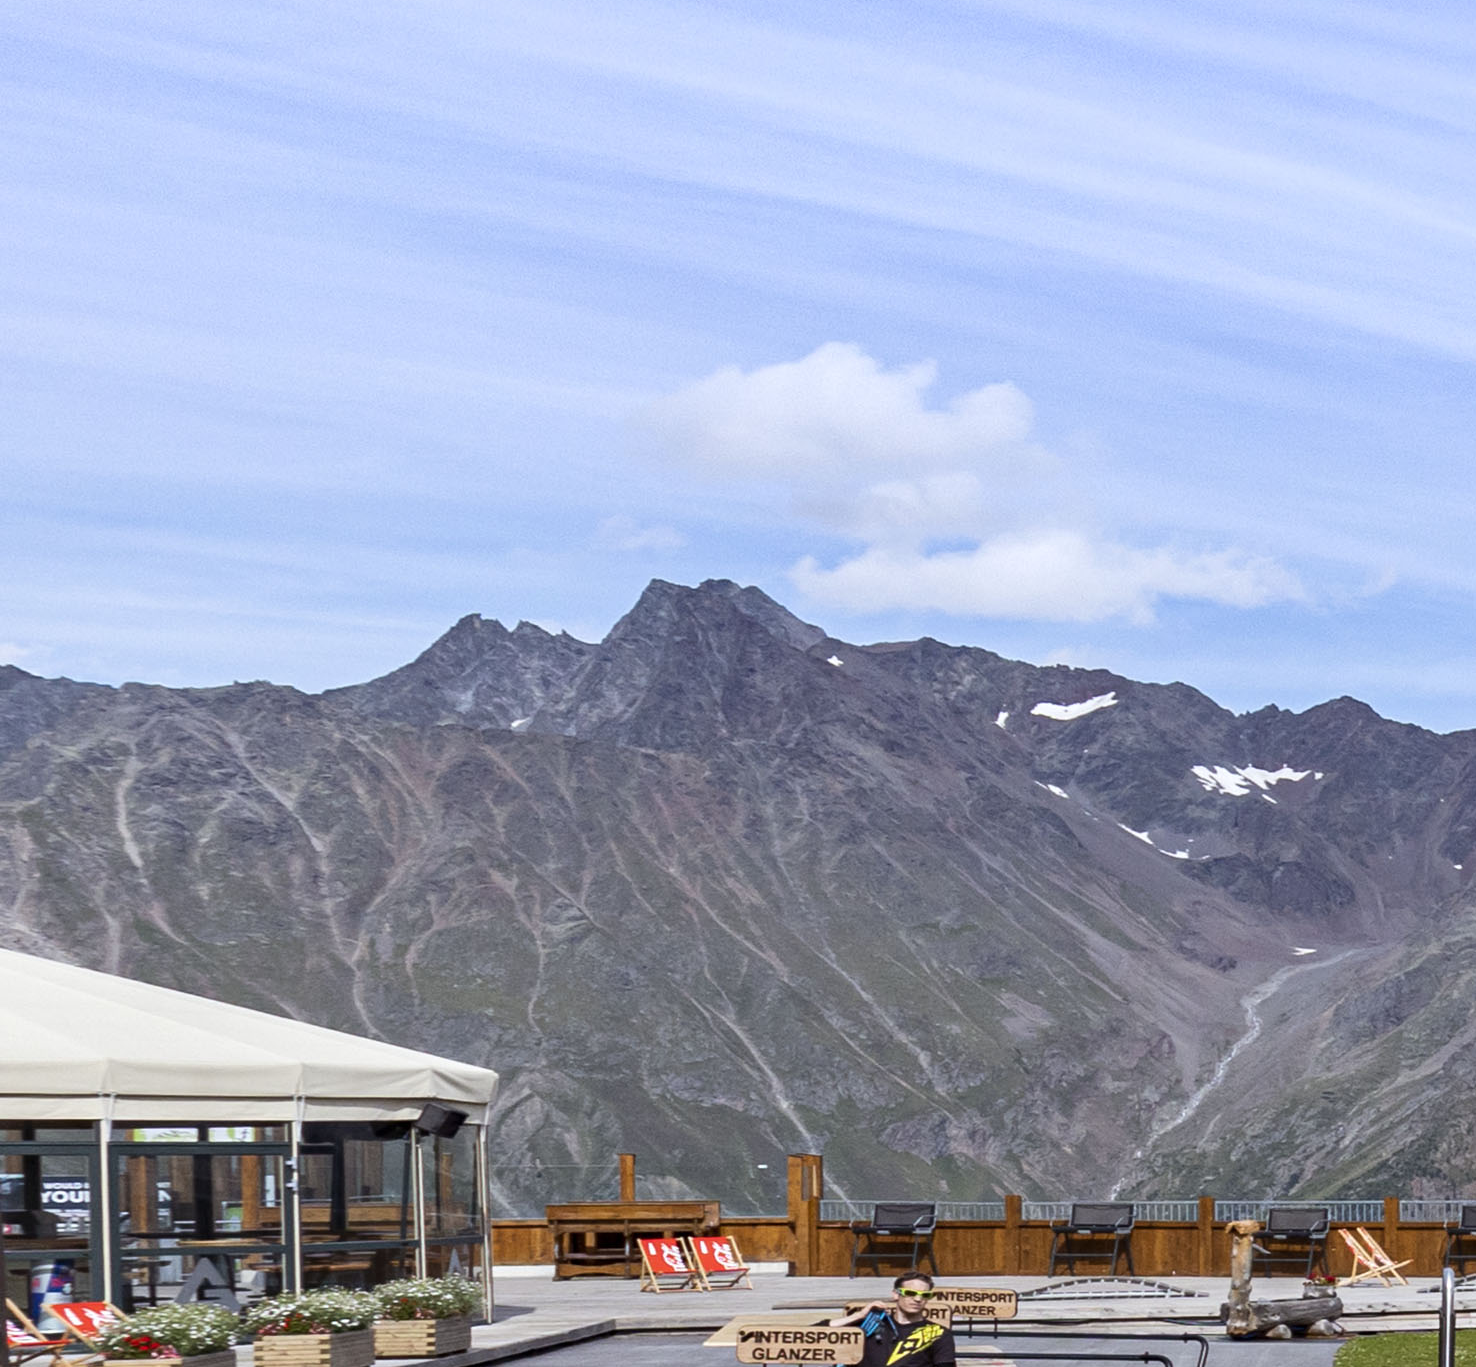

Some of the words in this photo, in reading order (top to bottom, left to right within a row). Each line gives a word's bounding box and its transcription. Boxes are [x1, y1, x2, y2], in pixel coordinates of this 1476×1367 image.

[937, 1291, 1015, 1304] INTERSPORT
[754, 1330, 862, 1345] INTERSPORT
[752, 1347, 836, 1361] GLANZER
